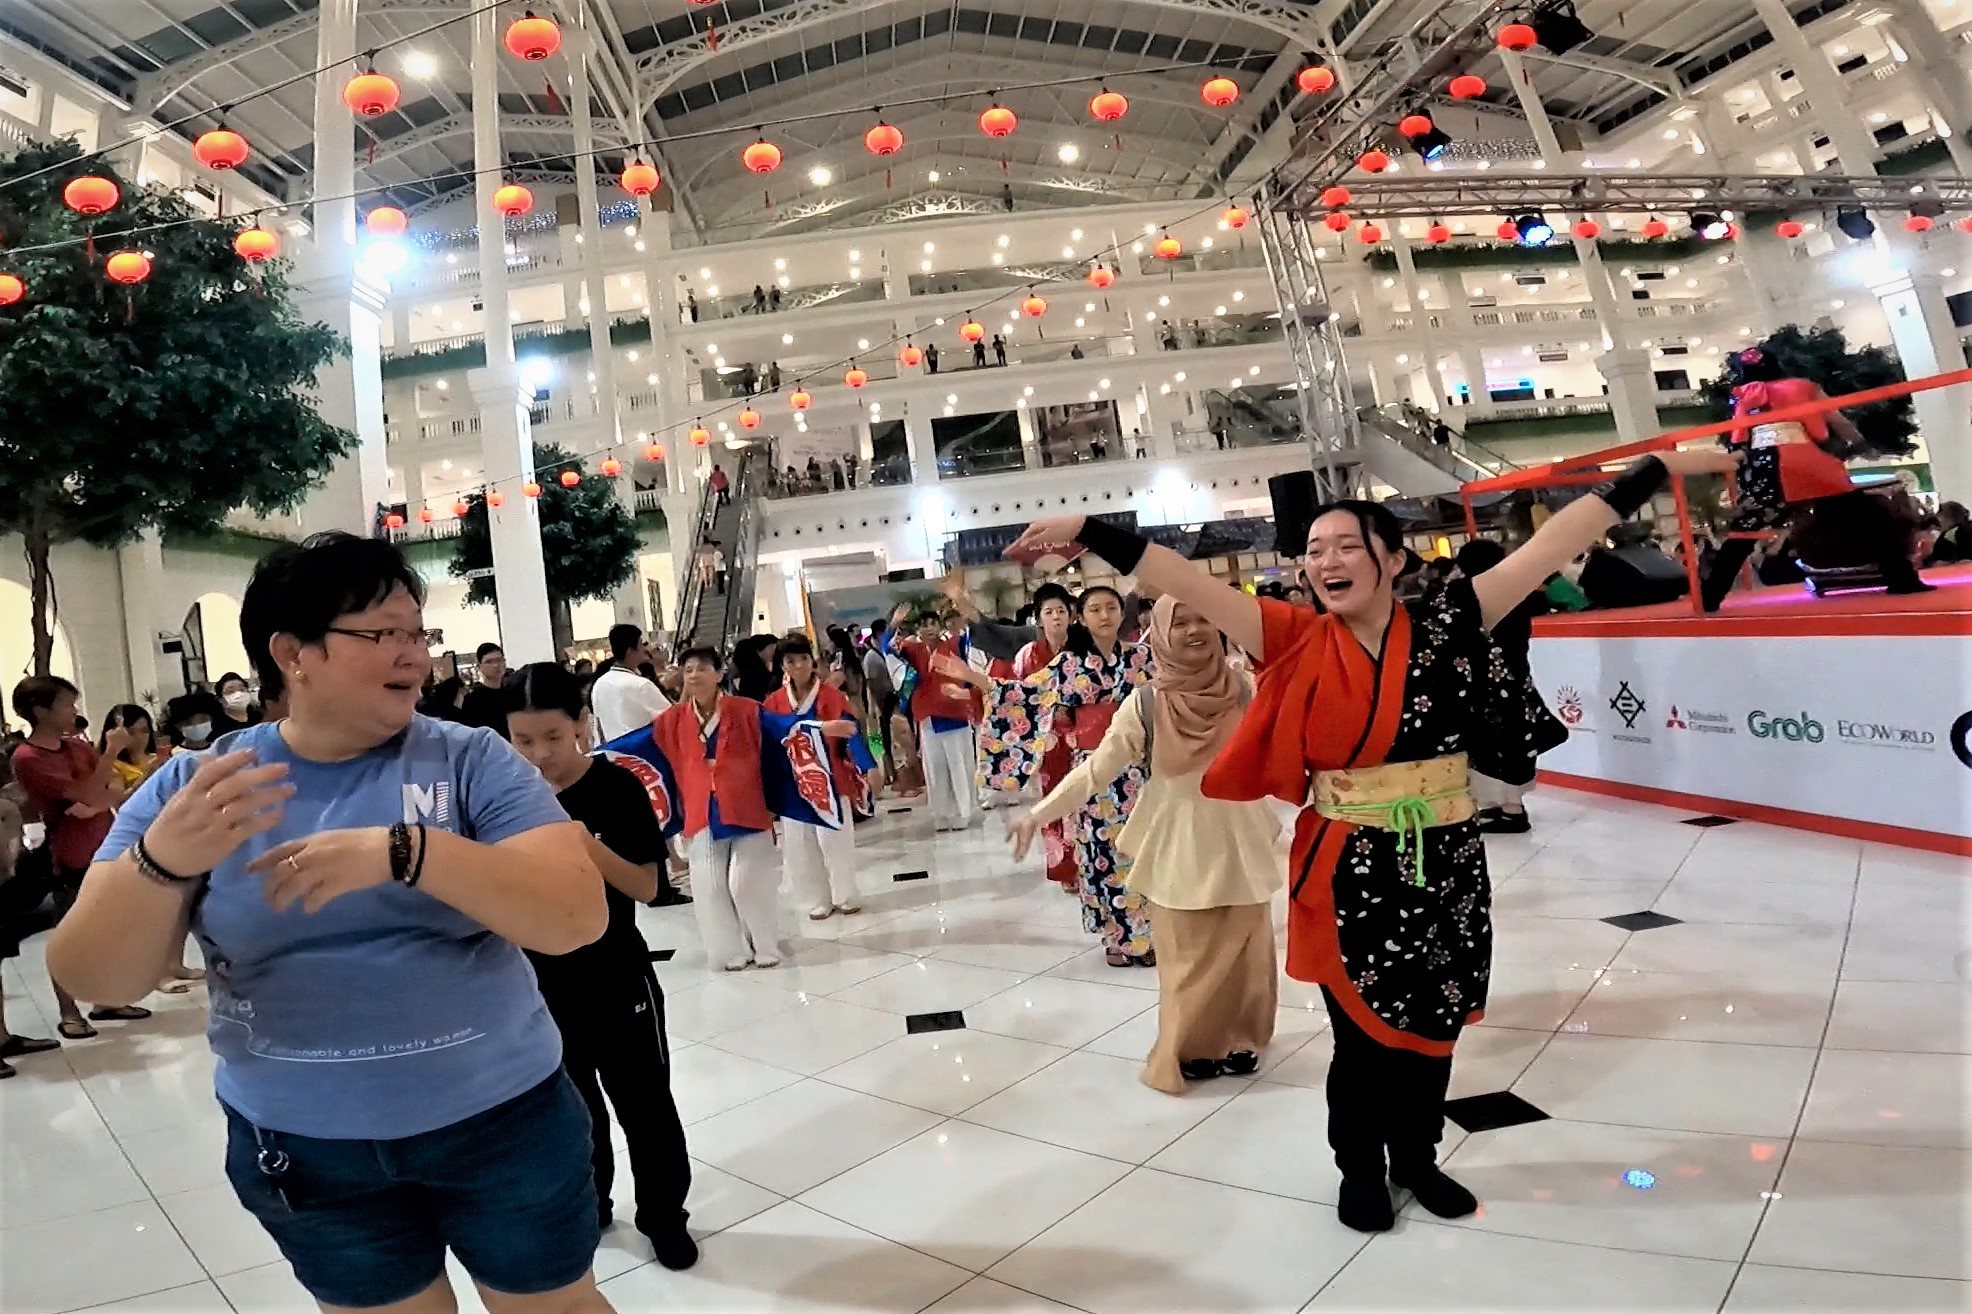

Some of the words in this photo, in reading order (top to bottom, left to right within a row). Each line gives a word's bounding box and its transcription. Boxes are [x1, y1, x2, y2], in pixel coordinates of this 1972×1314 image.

[1747, 710, 1824, 743] Grab
[348, 1045, 376, 1056] and
[382, 1039, 427, 1052] lovely
